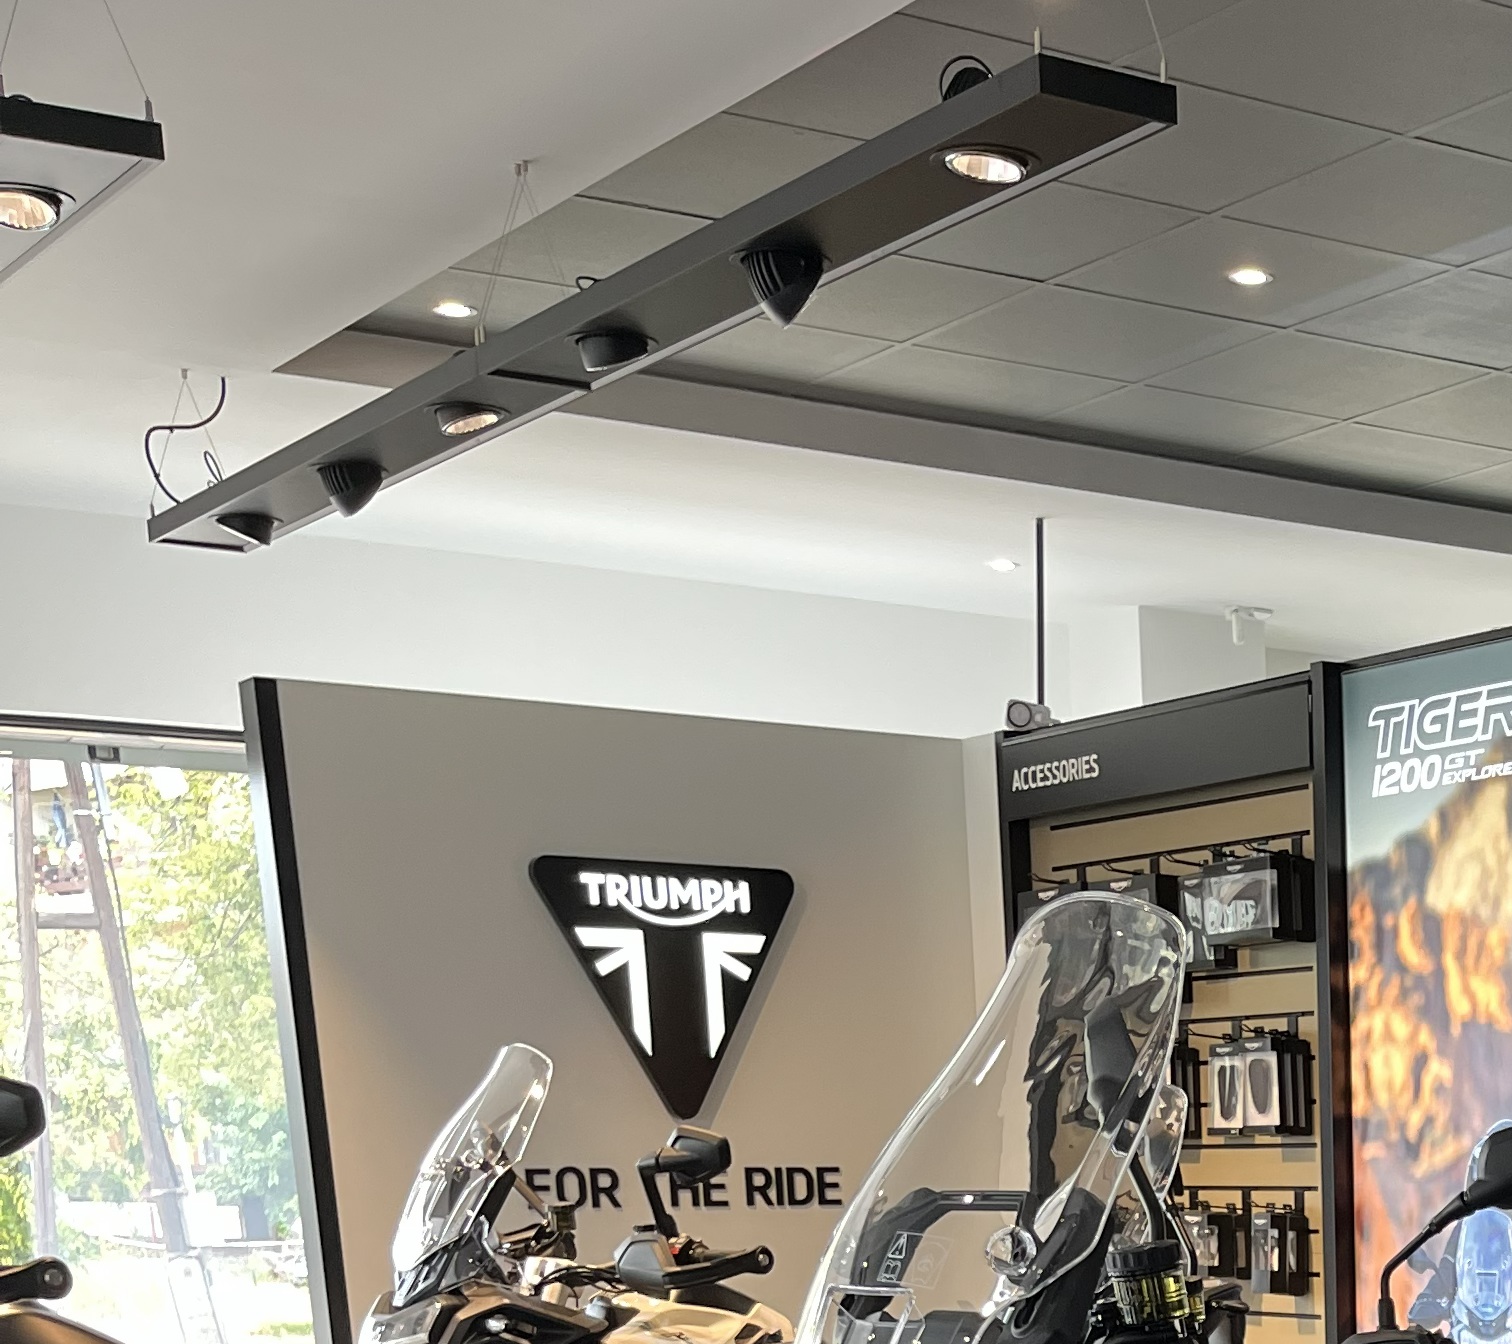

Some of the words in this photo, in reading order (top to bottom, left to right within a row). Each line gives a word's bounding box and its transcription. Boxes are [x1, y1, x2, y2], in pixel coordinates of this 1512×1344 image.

[1011, 753, 1100, 792] ACCESSORIES
[1372, 753, 1440, 798] 1200
[1443, 749, 1485, 771] GT
[579, 872, 751, 924] TRIUMPH
[525, 1166, 621, 1209] FOR
[655, 1166, 729, 1208] HE
[744, 1166, 844, 1207] RIDE
